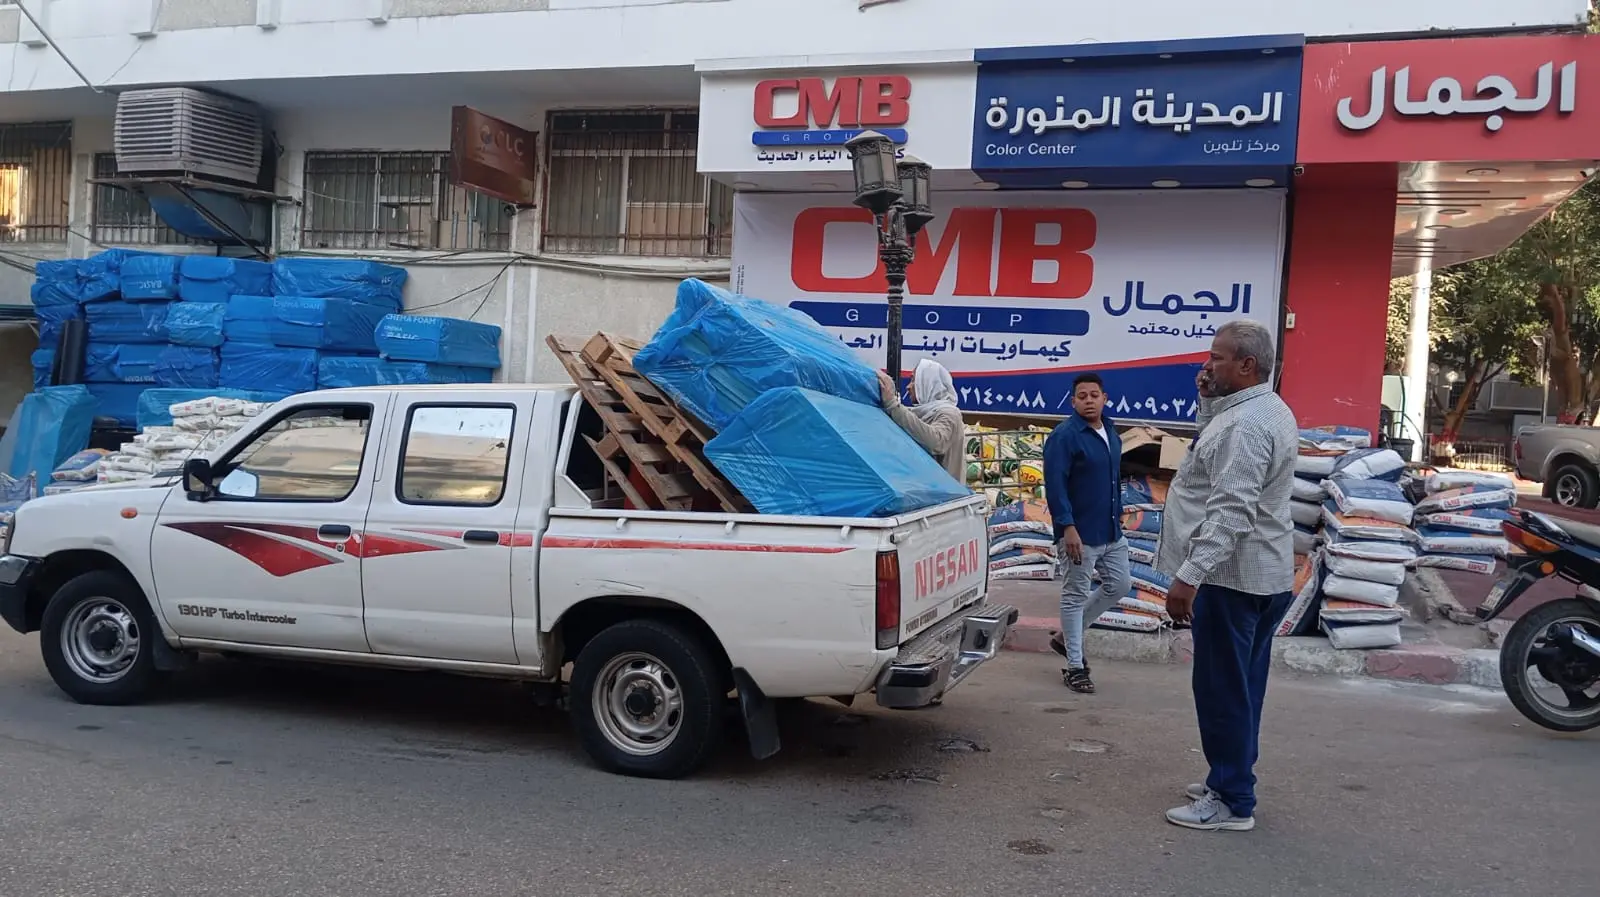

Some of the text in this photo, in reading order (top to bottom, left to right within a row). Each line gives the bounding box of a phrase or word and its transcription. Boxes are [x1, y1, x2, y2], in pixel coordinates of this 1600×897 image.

[753, 75, 912, 128] CMB
[1337, 61, 1576, 131] الجمال
[986, 88, 1283, 134] المدينة المنورة
[782, 133, 853, 142] GROU
[1203, 139, 1280, 154] مركز تلوين
[757, 150, 803, 164] الحديث
[809, 149, 843, 163] البناء
[985, 142, 1077, 156] Color Center
[791, 207, 1097, 300] CMB
[1103, 280, 1252, 319] الجمال
[845, 308, 1023, 327] GOUP
[1128, 322, 1216, 338] كيل معتمد
[901, 335, 955, 356] البنا
[960, 336, 1072, 362] كيماويات
[960, 386, 1046, 409] ٢١٤٠٠٨٨
[914, 539, 978, 600] NISSAN
[178, 604, 297, 624] 130 HP Turbo Intercooler
